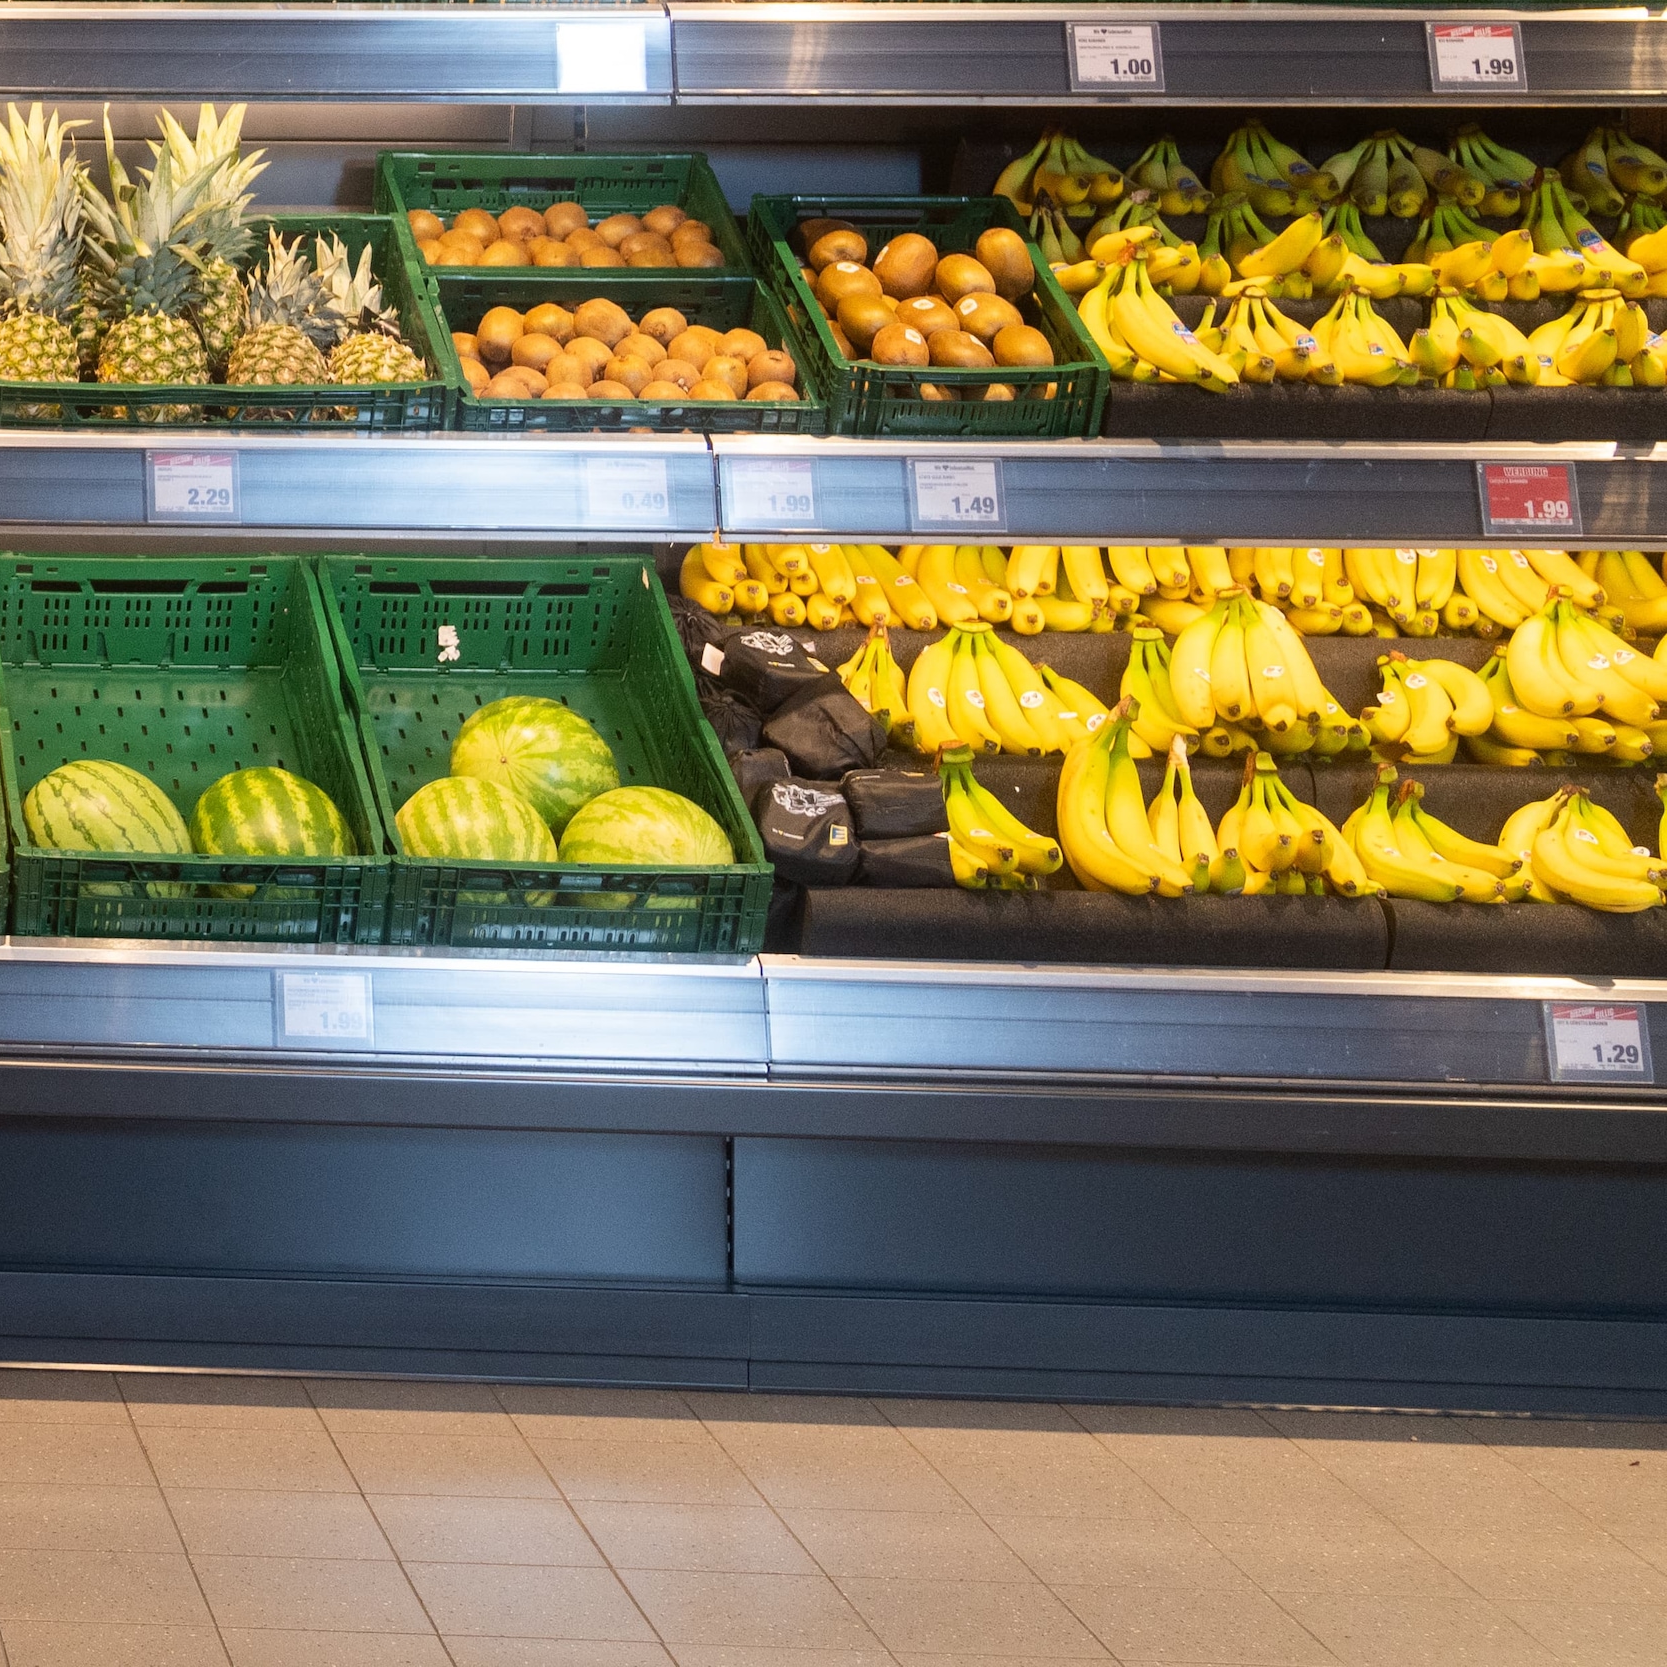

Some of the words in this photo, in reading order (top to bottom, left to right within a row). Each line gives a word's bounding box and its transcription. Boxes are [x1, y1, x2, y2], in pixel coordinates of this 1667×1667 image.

[1110, 58, 1152, 75] 1.00
[1472, 59, 1514, 75] 1.99
[1503, 466, 1549, 477] WERBUNG
[188, 488, 230, 505] 2.29
[768, 495, 810, 512] 1.99
[951, 496, 994, 514] 1.49
[1524, 500, 1568, 519] 1.99
[320, 1011, 363, 1030] 1.99
[1593, 1044, 1639, 1064] 1.29
